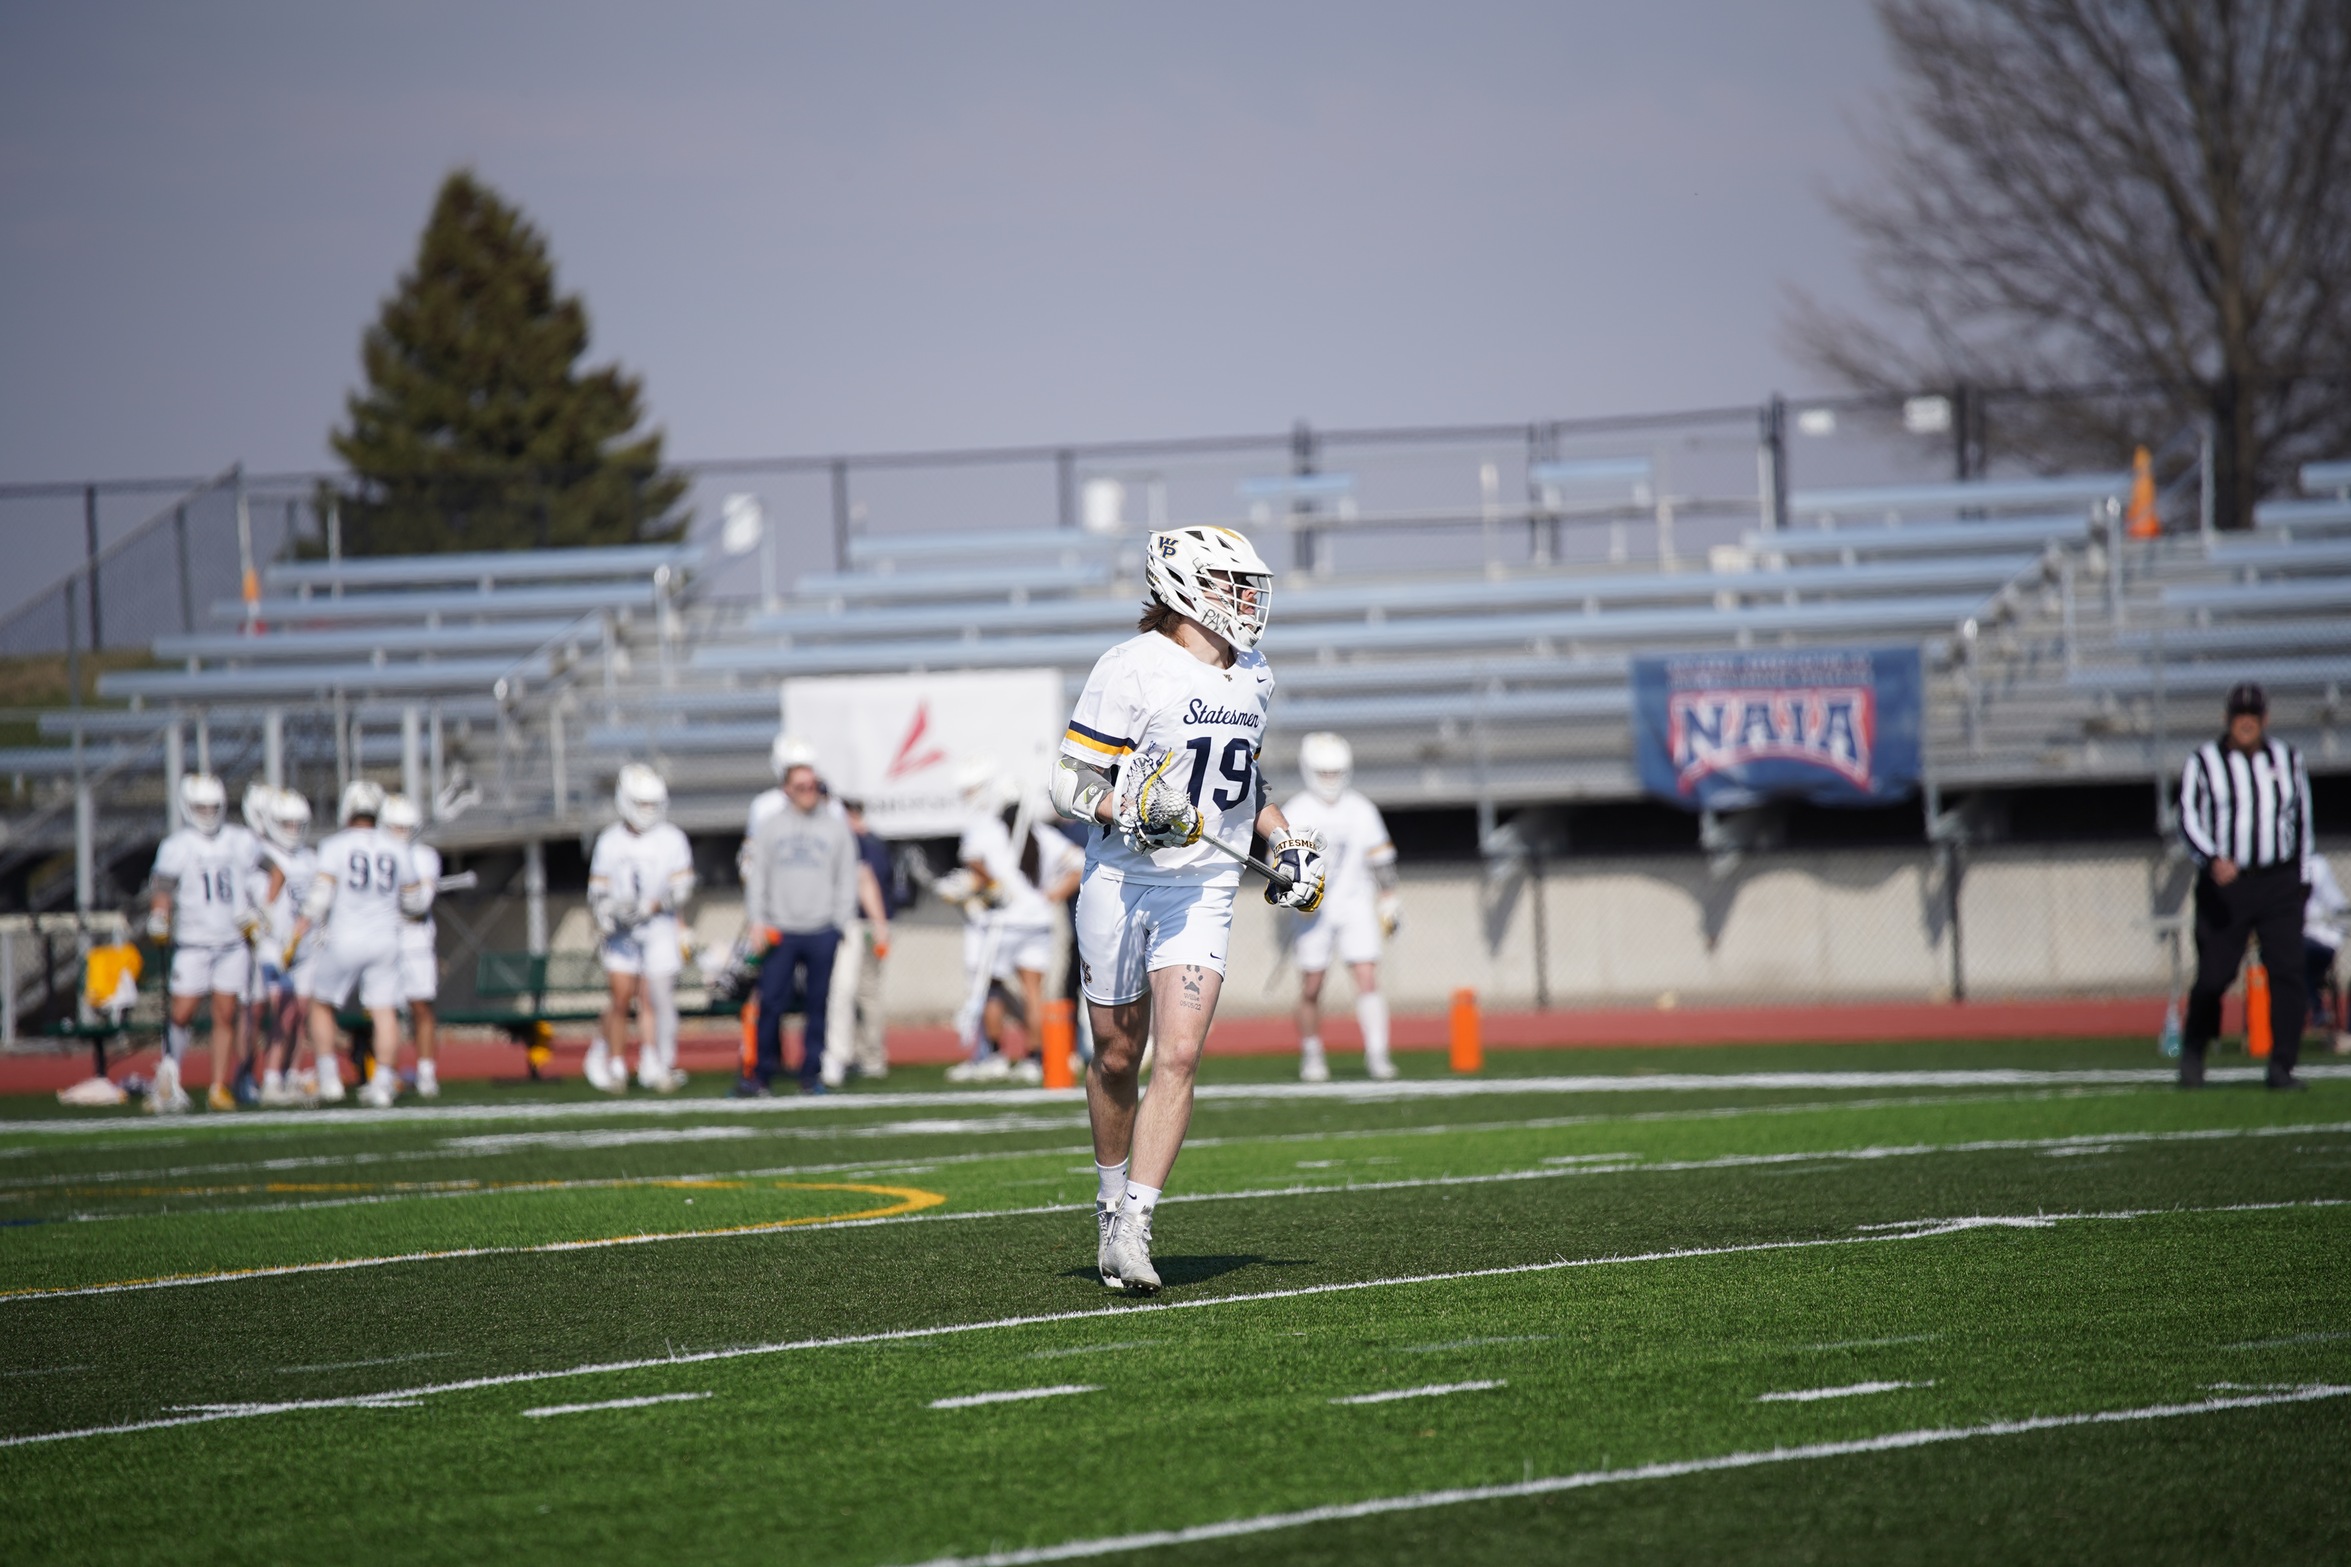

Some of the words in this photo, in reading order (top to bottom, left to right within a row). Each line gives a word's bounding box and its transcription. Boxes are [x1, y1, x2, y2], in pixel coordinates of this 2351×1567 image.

[1201, 609, 1229, 635] PAM
[1183, 698, 1260, 729] Statesmen
[1667, 687, 1876, 793] NAIA
[1186, 736, 1253, 812] 19
[350, 850, 398, 896] 99
